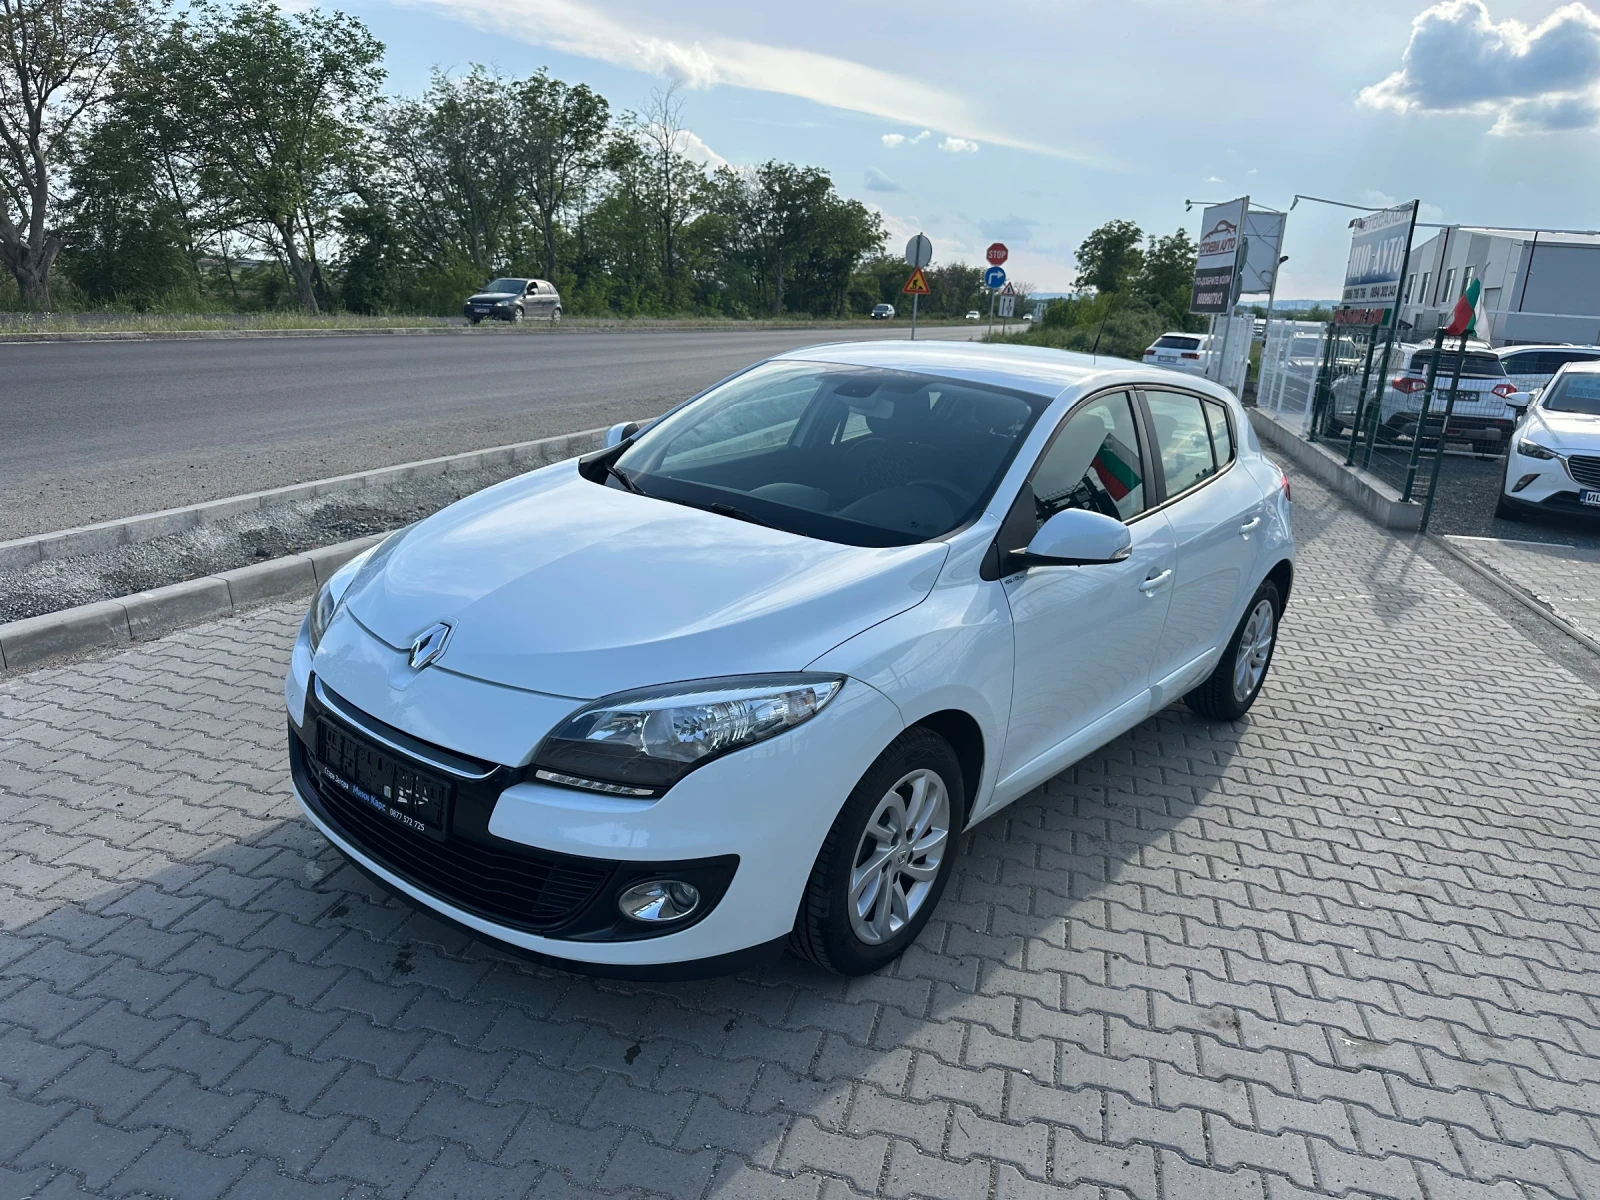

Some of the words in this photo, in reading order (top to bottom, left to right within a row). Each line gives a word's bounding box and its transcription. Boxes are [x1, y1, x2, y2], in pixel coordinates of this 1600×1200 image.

[1219, 237, 1236, 251] АУТО
[988, 250, 1007, 259] STOP
[389, 808, 403, 819] 0877
[403, 815, 413, 826] 572
[414, 820, 425, 832] 725
